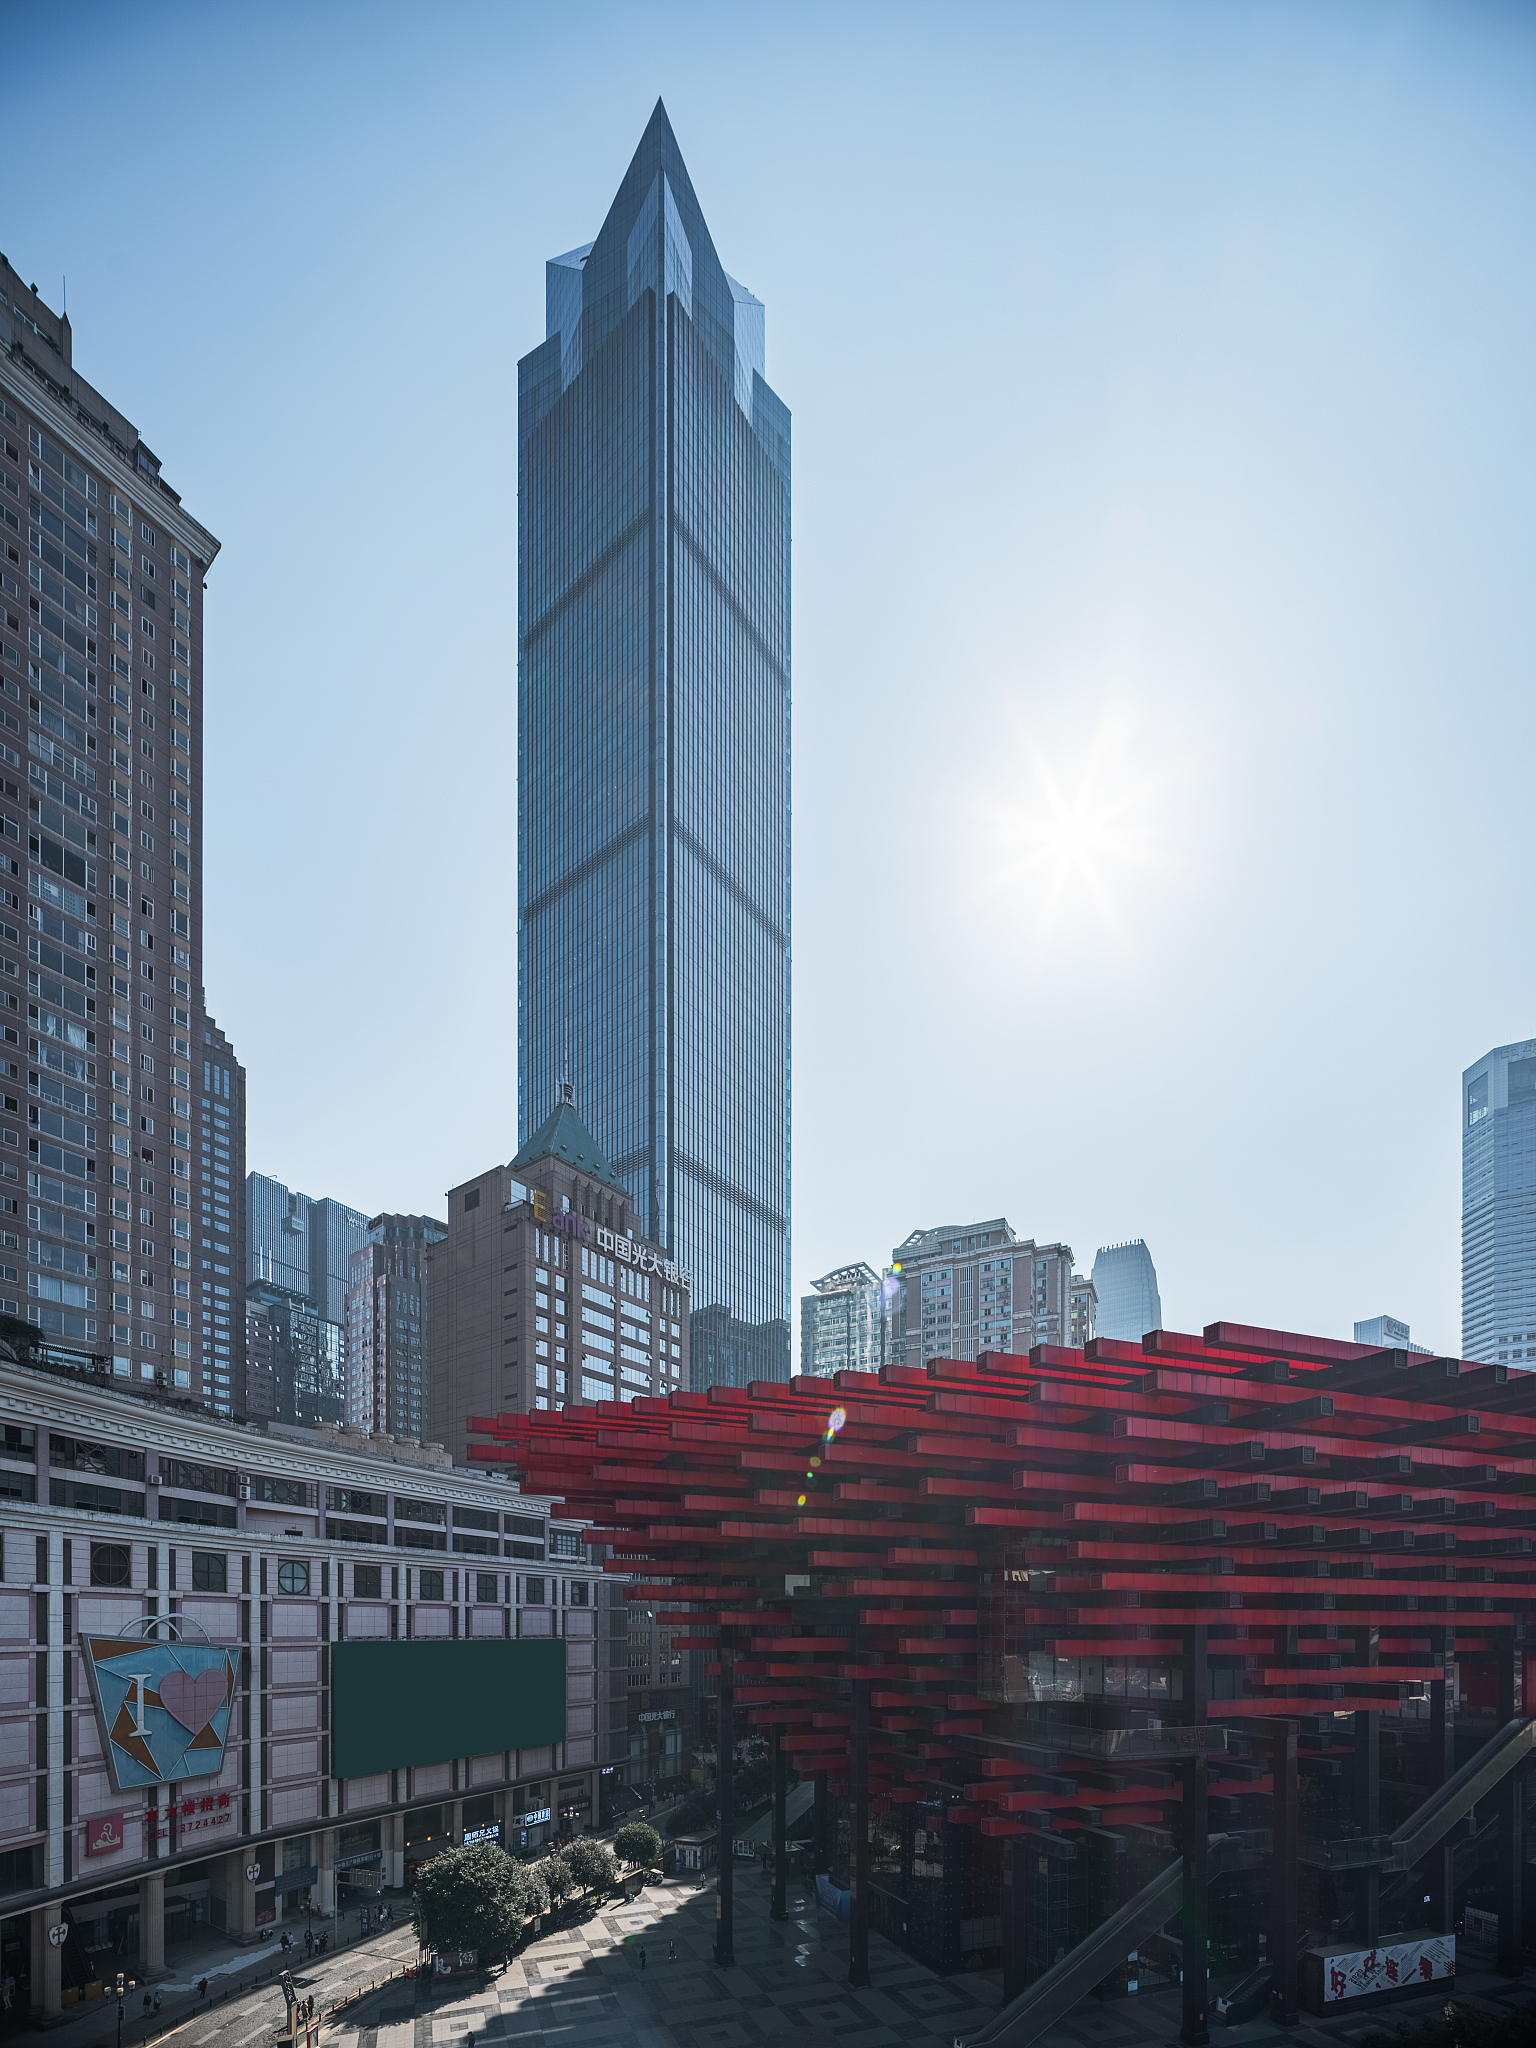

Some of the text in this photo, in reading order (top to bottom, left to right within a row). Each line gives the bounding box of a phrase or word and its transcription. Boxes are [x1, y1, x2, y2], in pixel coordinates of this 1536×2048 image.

[597, 1227, 693, 1291] 中国光大银行
[638, 1709, 676, 1722] 中国光大银行
[1348, 1968, 1364, 1983] 2020
